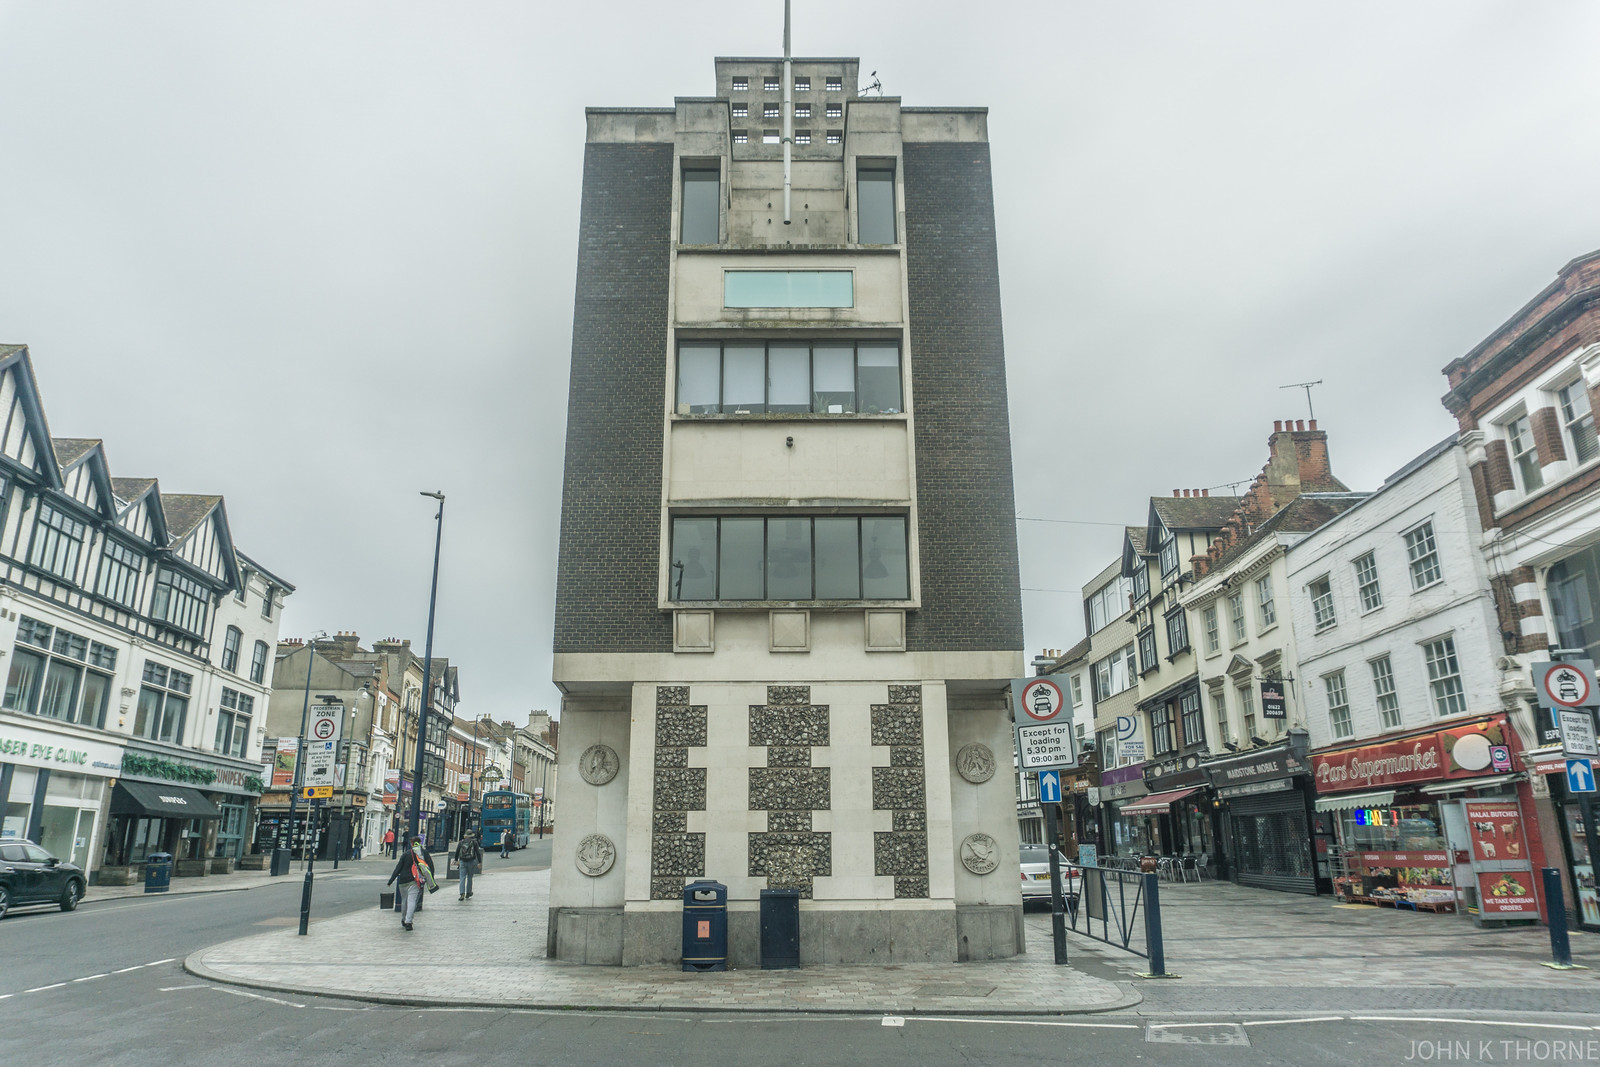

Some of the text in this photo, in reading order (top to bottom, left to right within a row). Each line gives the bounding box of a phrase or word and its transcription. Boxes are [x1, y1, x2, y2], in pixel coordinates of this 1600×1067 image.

[1562, 714, 1581, 724] Except
[1022, 728, 1051, 737] Except
[1567, 724, 1588, 734] loading
[1030, 737, 1060, 746] loading
[29, 743, 54, 760] EYE
[55, 747, 88, 765] CLINIC
[1027, 746, 1047, 754] 5.30
[1031, 755, 1052, 763] 09:00
[1317, 762, 1348, 783] Pars
[1349, 742, 1438, 786] Supermarket
[1226, 766, 1257, 779] MAIDSTONE
[1255, 761, 1279, 774] MOBILE
[1490, 810, 1519, 818] BUTCHER
